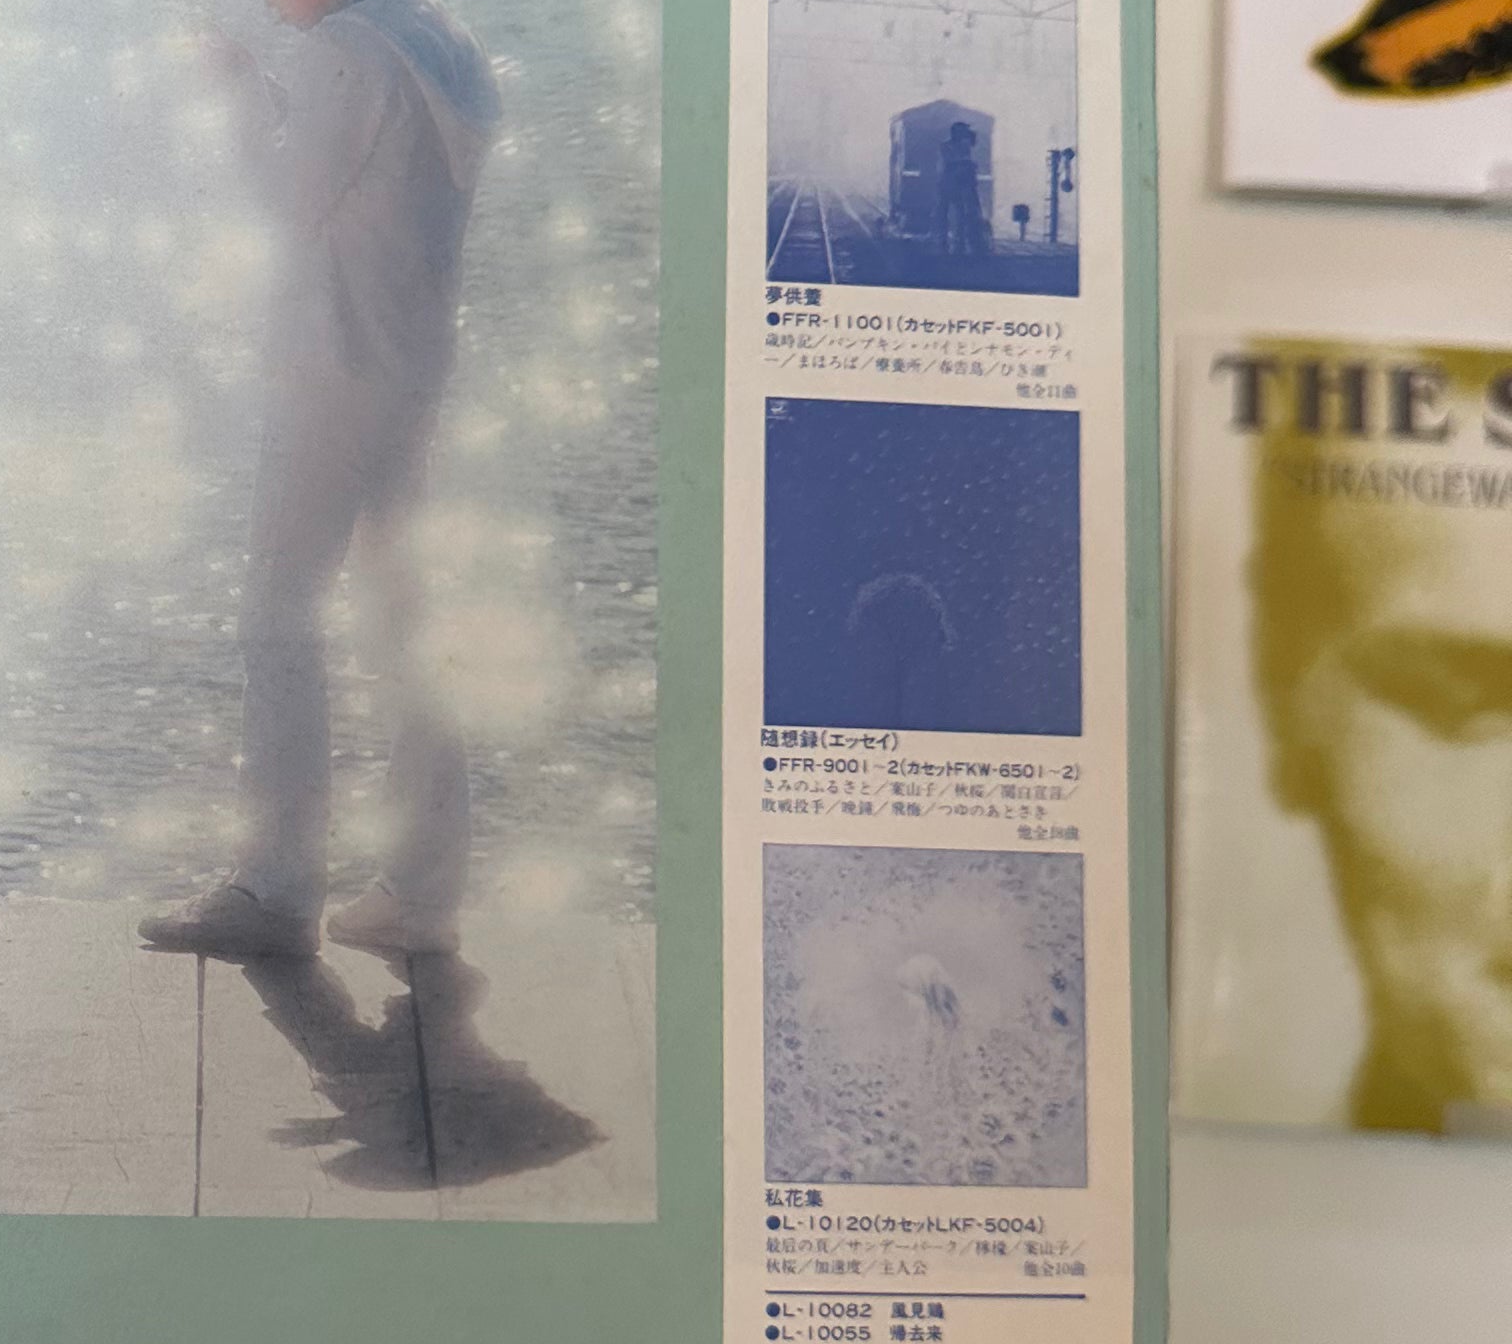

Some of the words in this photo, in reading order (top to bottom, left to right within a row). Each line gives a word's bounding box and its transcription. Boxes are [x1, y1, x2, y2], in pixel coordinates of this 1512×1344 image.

[765, 286, 822, 306] 夢供養
[1209, 353, 1454, 445] THE
[765, 1189, 823, 1207] 私花集
